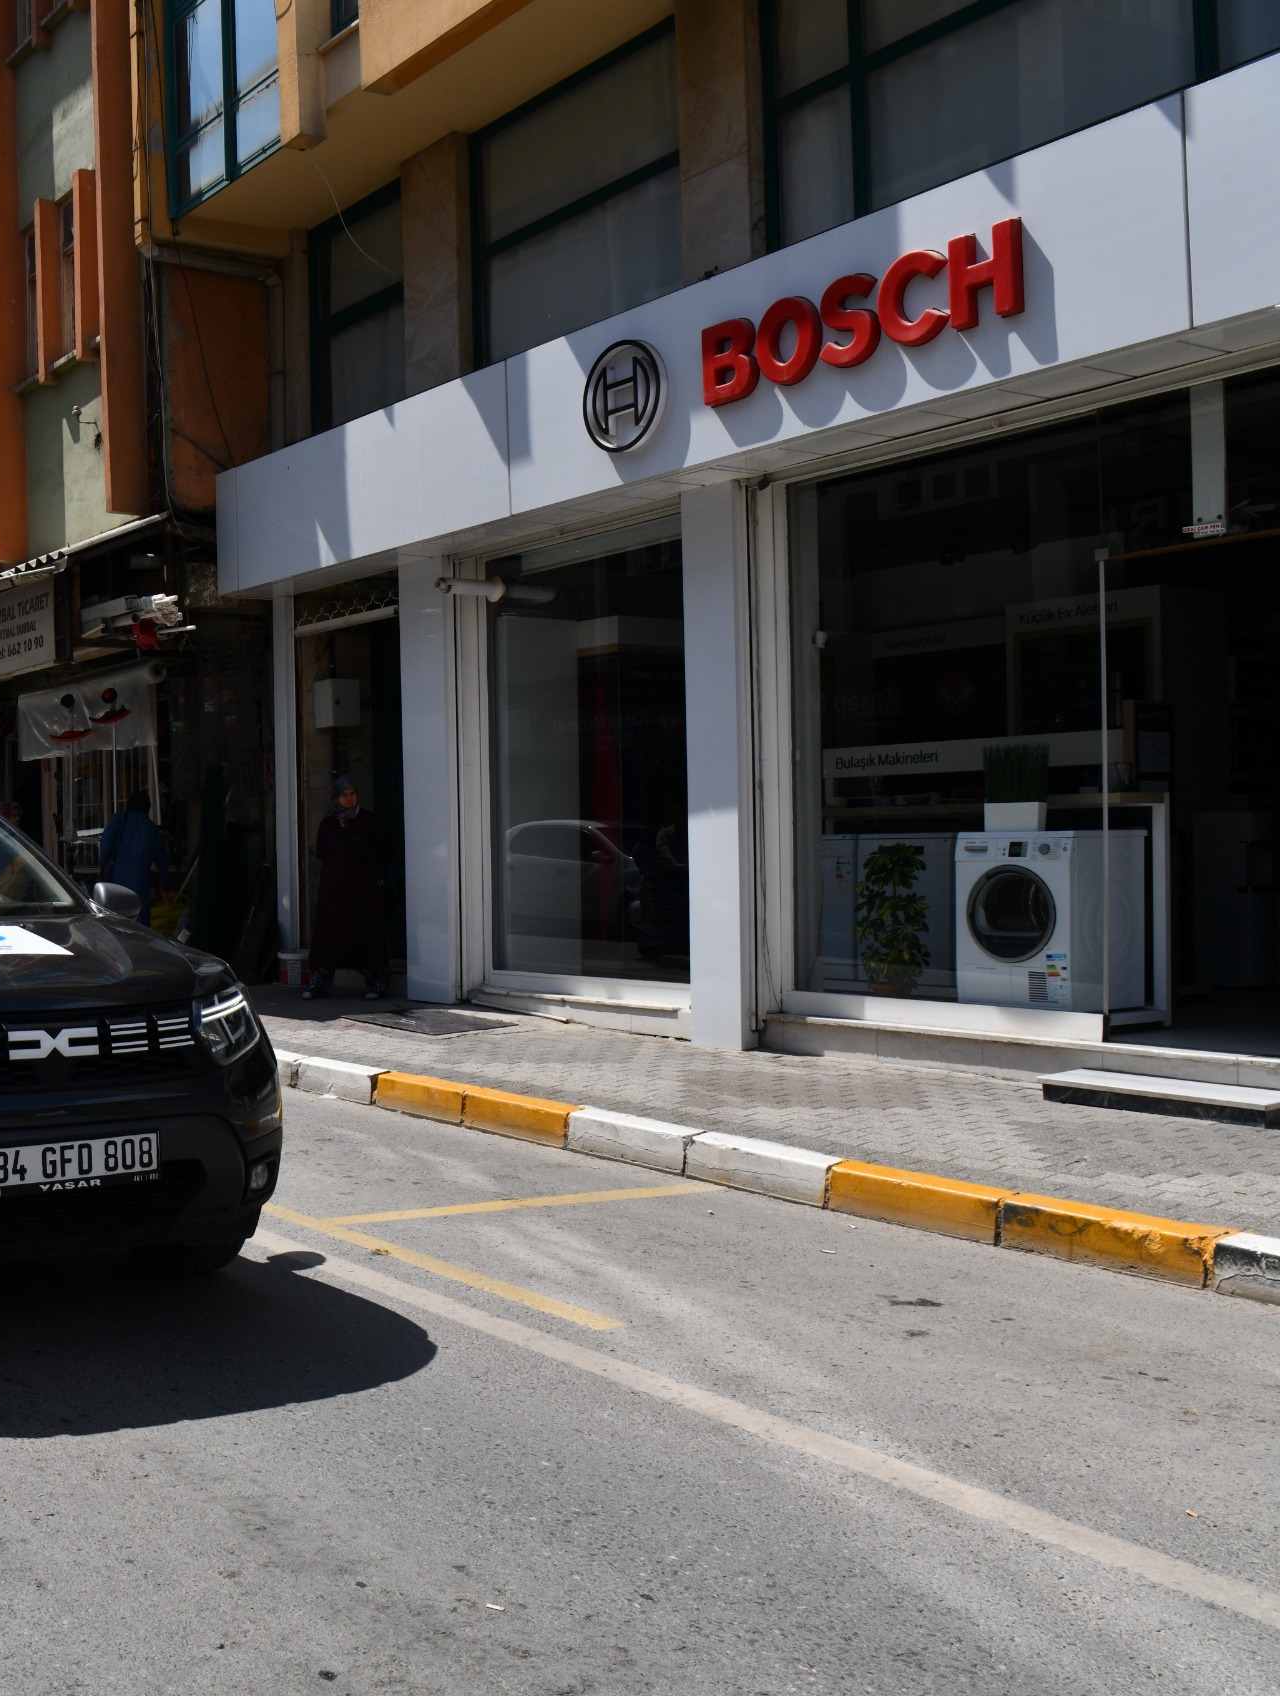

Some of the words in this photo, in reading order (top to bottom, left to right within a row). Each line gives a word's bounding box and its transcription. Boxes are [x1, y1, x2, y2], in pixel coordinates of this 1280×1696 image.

[701, 217, 1025, 408] BOSCH
[1019, 609, 1055, 625] Küçük
[1058, 606, 1072, 620] Ev
[1075, 600, 1117, 616] Aleteri
[0, 626, 16, 641] KEMAL
[16, 620, 36, 636] DURBAL
[883, 633, 947, 651] Televizyonlar
[7, 641, 21, 657] 662
[24, 638, 33, 653] 10
[34, 634, 44, 650] 90
[835, 752, 876, 771] Bulaşık
[878, 749, 939, 767] Makineleri
[41, 1142, 93, 1179] GFD
[104, 1136, 154, 1172] 808
